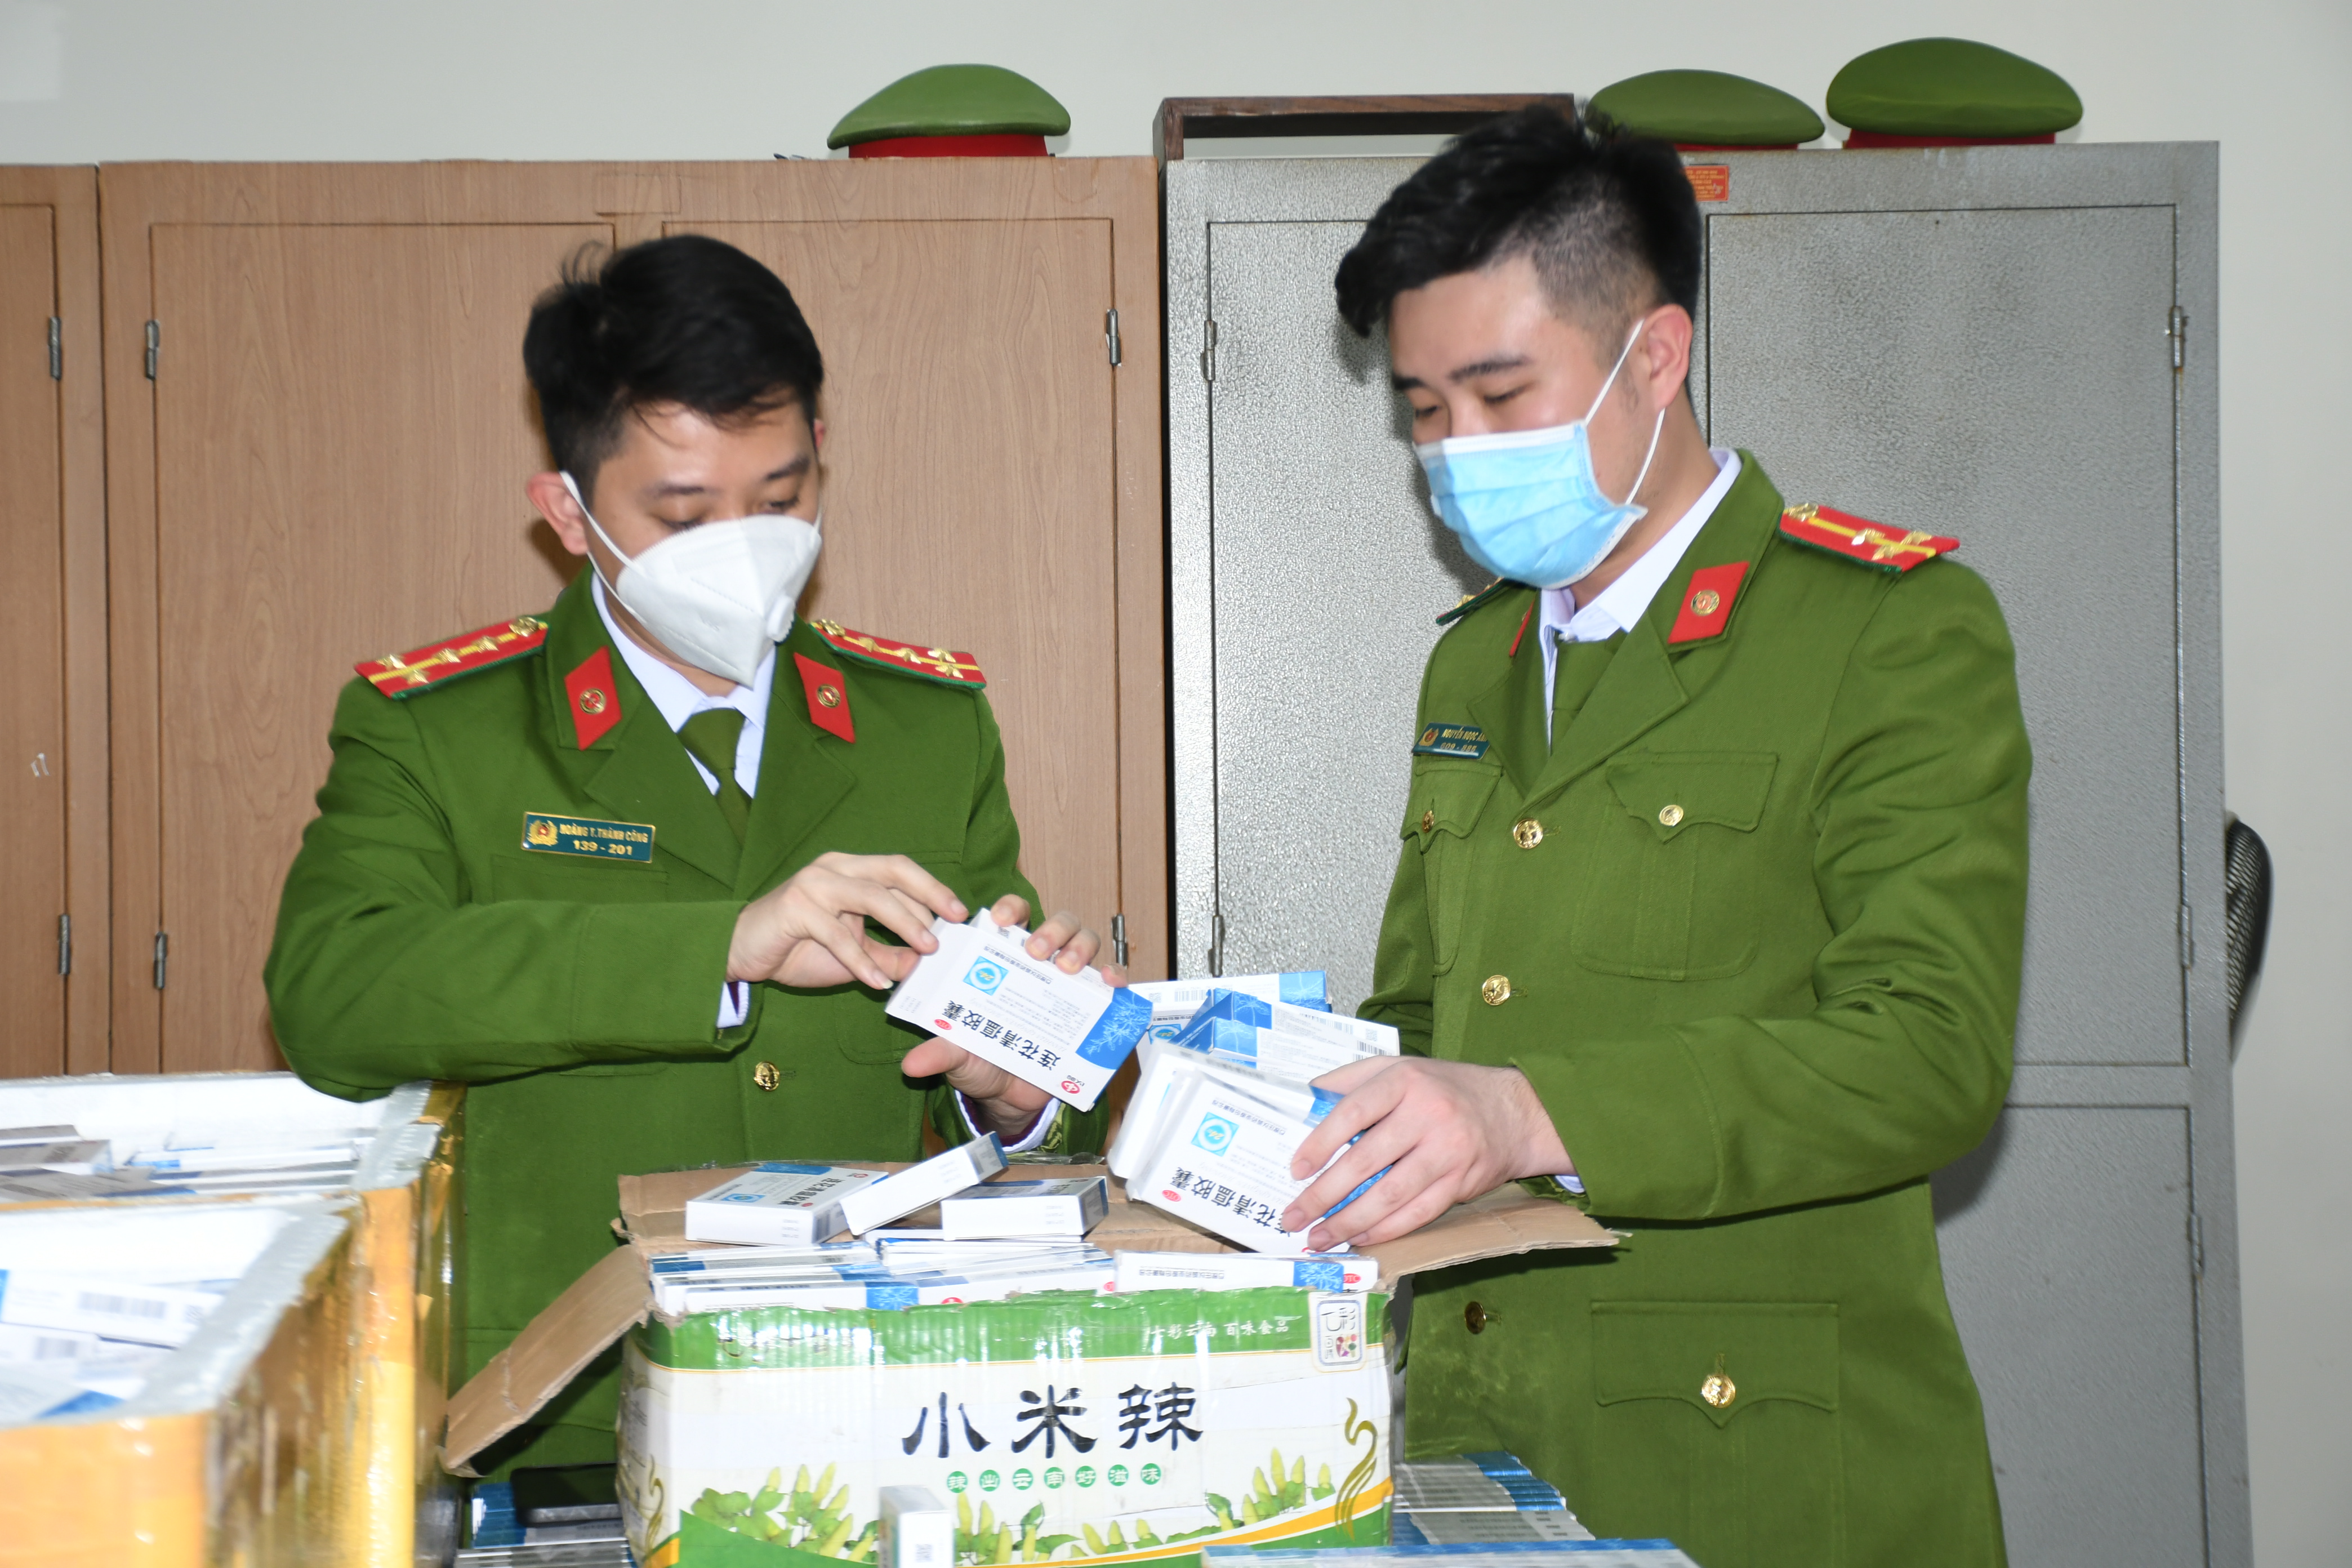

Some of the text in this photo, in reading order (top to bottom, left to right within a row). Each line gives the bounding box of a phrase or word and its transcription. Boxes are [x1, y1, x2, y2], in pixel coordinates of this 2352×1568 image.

[573, 840, 598, 852] 139
[608, 844, 632, 856] 201
[935, 1019, 951, 1031] OTC
[942, 1000, 1062, 1071] 连花清瘟胶囊
[1163, 1190, 1181, 1202] OTC
[1223, 1320, 1289, 1336] 百味食品
[902, 1382, 1203, 1459] 小米辣
[947, 1467, 1160, 1491] 辣出云南好滋味
